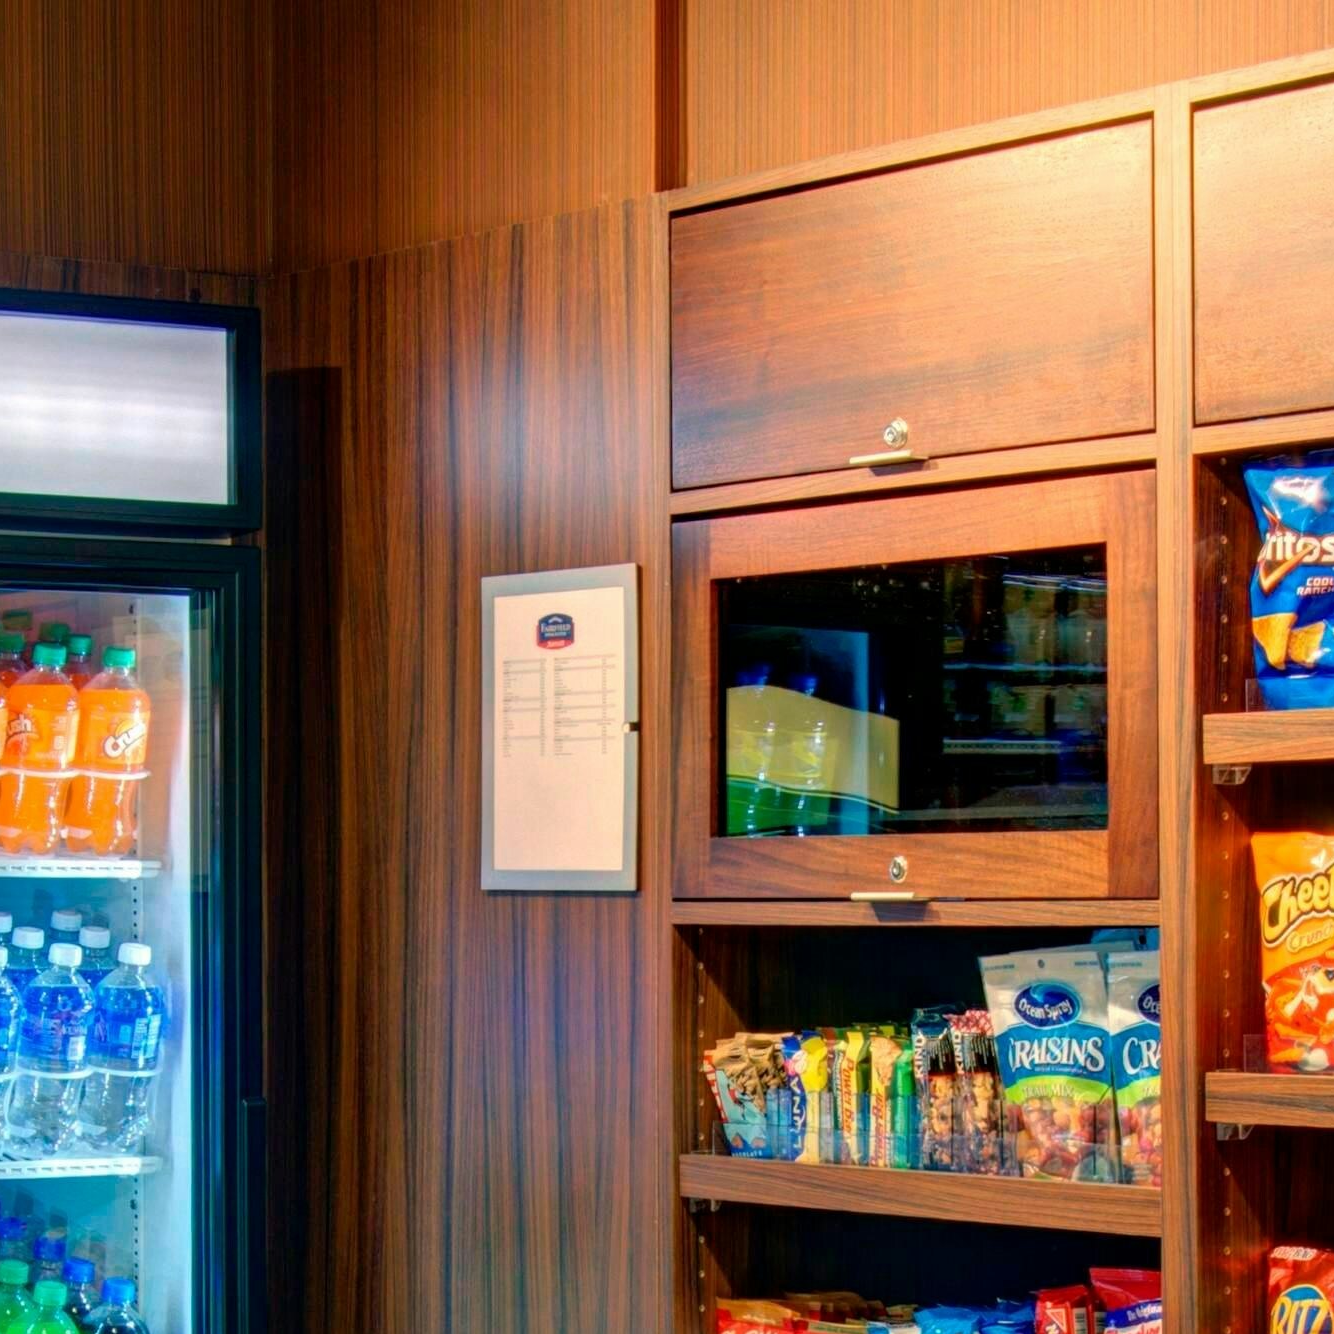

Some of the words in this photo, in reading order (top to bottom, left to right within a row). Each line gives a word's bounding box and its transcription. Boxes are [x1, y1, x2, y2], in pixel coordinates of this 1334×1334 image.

[1018, 998, 1045, 1018] Ocean
[1045, 999, 1072, 1020] Spray
[1142, 997, 1161, 1015] Oce
[790, 1076, 803, 1149] LUNA
